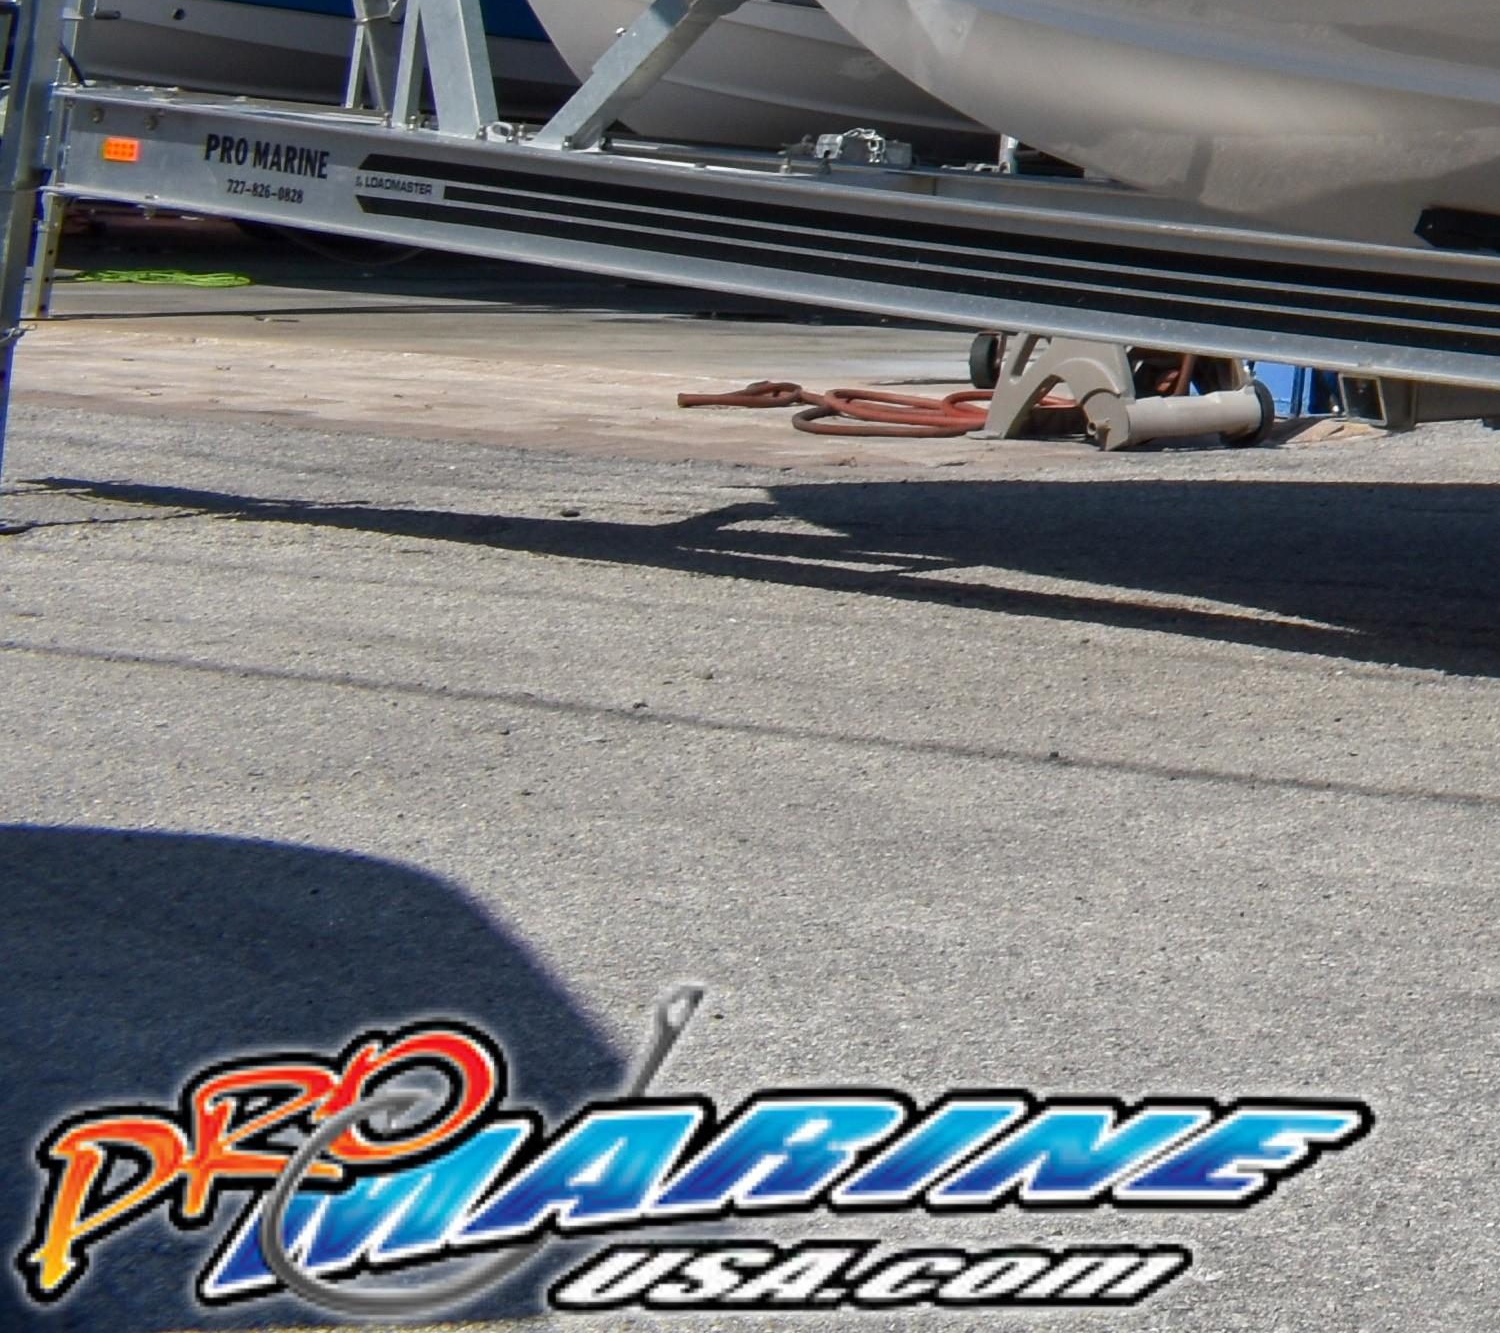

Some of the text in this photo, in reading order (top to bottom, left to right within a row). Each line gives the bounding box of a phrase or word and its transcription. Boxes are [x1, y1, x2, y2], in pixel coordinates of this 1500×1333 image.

[204, 133, 330, 180] PRO MARINE
[226, 178, 304, 204] 727-826-0828
[365, 175, 433, 196] LOADMASTER
